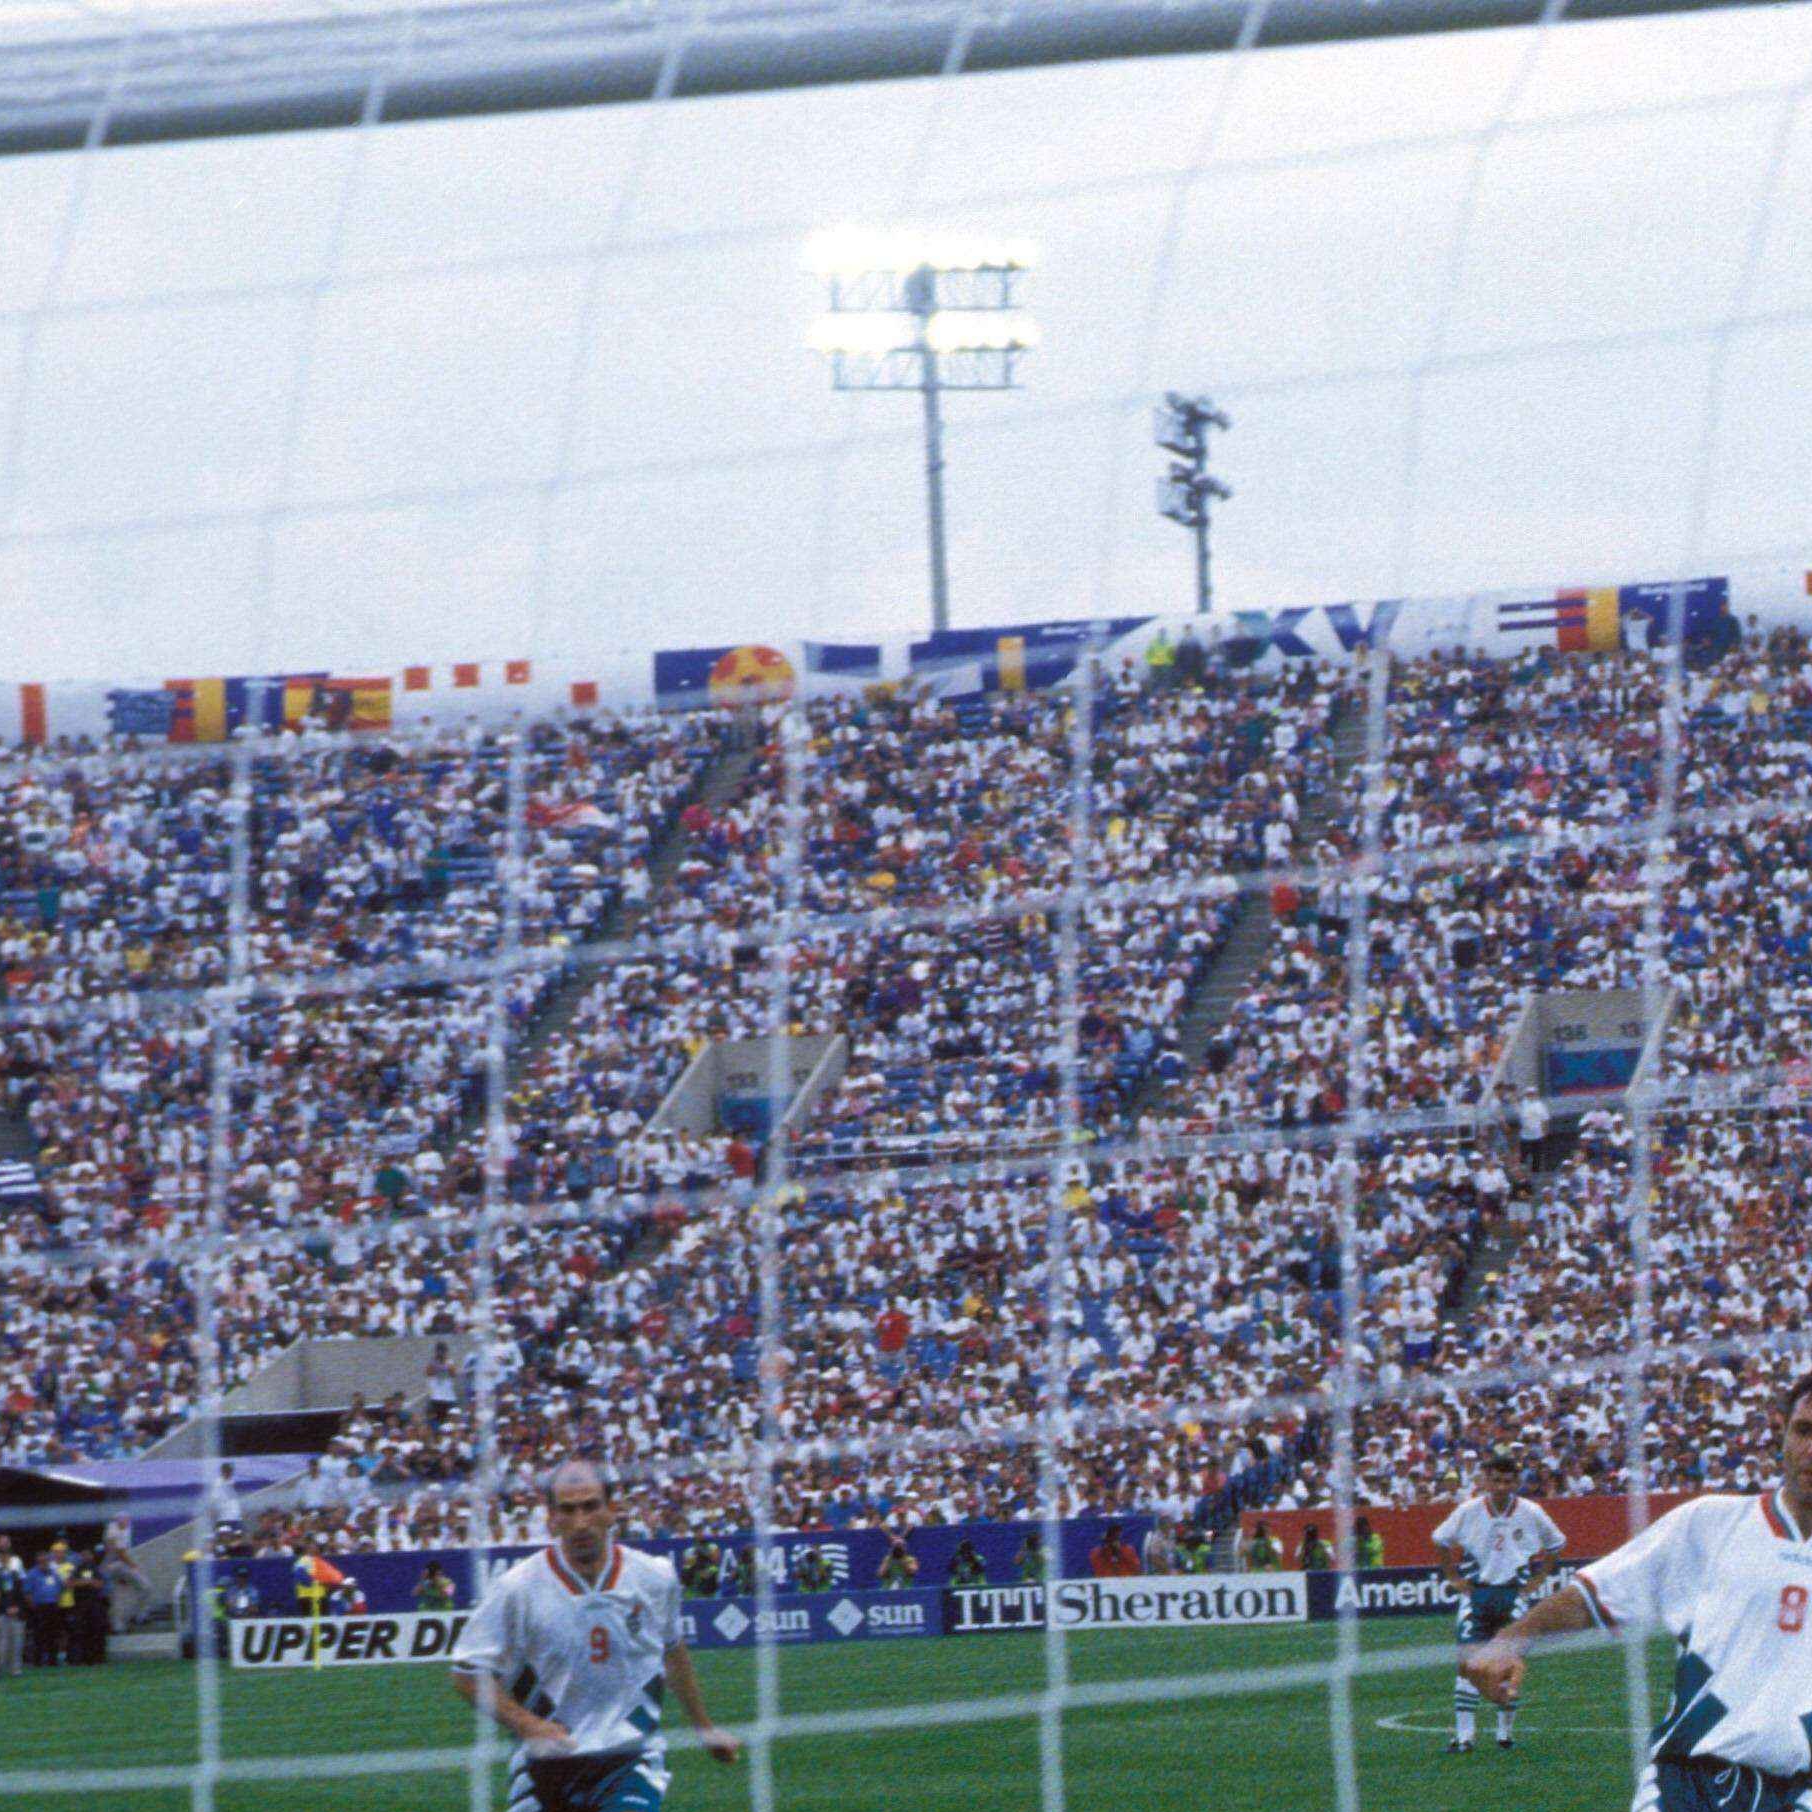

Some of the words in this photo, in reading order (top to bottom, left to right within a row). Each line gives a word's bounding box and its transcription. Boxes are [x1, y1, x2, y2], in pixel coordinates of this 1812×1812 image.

[953, 1585, 1047, 1632] ITT
[1054, 1577, 1300, 1625] Sheraton
[1335, 1571, 1460, 1610] Americ
[1777, 1585, 1809, 1632] 8
[754, 1608, 810, 1632] sun
[867, 1602, 924, 1626] sun
[241, 1619, 400, 1665] UPPER
[589, 1624, 610, 1664] 9
